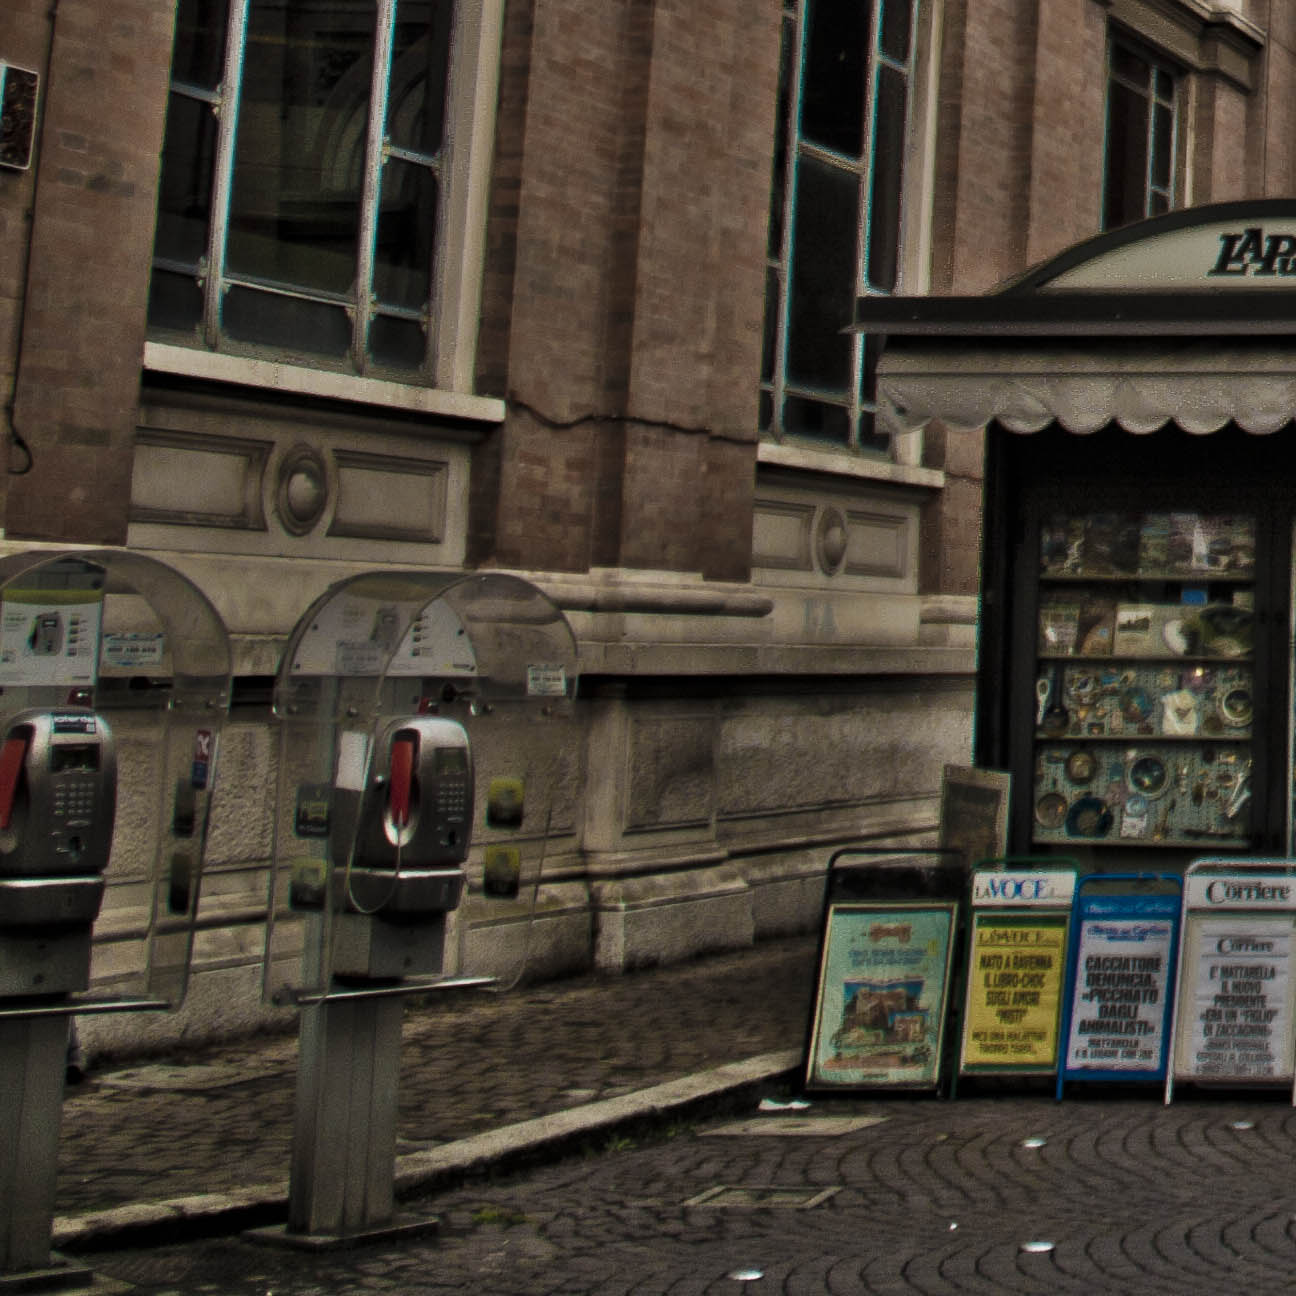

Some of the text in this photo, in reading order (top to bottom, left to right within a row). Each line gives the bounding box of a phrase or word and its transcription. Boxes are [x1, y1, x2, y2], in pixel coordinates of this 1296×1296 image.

[990, 879, 1049, 899] VOCE
[1206, 882, 1291, 903] Corriere
[1217, 939, 1274, 954] Corriere
[979, 955, 1003, 970] NATO
[1004, 955, 1011, 970] A
[1085, 956, 1161, 973] CACCIATORE
[1220, 965, 1275, 980] MATTARELLA
[1231, 981, 1262, 994] NUOVO
[1214, 995, 1267, 1008] PRESIDENTE
[1098, 1004, 1139, 1019] DAGLI
